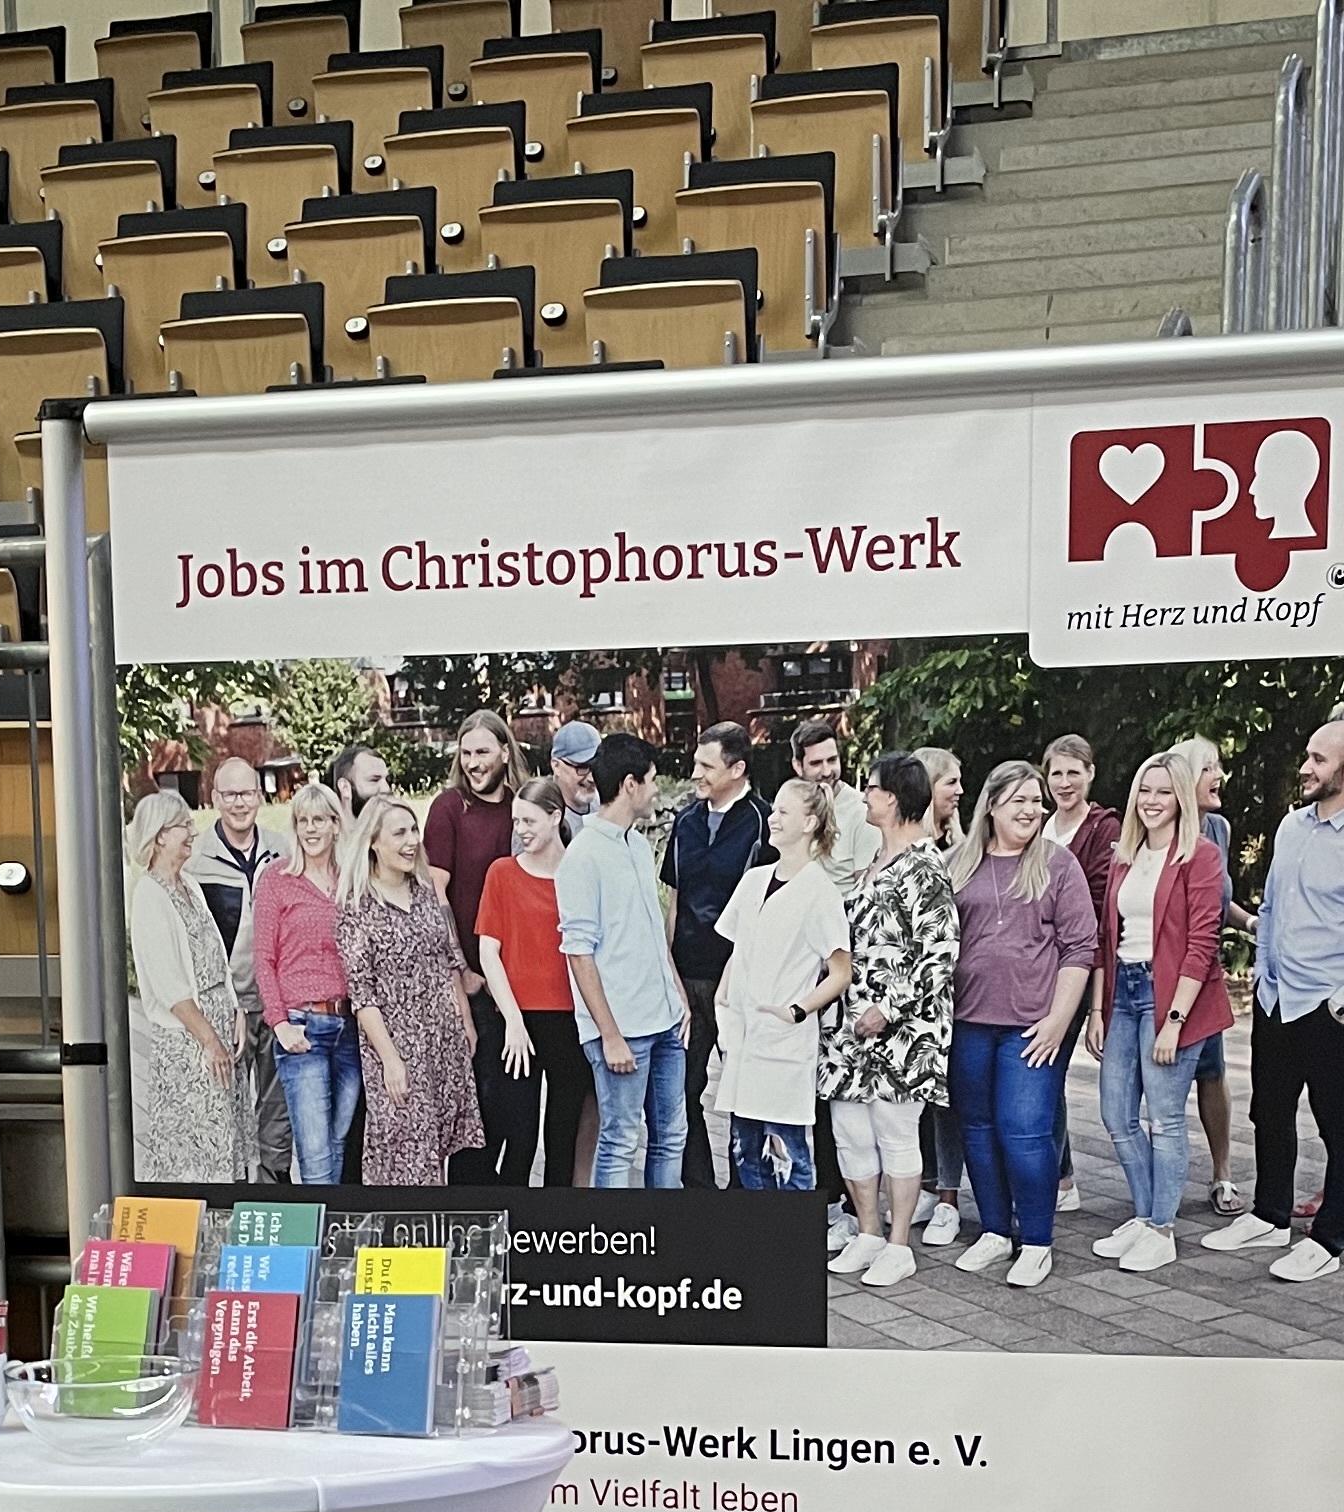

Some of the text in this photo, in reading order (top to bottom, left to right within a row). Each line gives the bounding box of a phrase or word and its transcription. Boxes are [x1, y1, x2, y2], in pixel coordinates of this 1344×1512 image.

[176, 516, 962, 608] Jobs im Christophorus-Werk
[1067, 592, 1326, 631] mit Herz und Kopf
[135, 1207, 149, 1243] Wied
[238, 1211, 252, 1247] bis D
[270, 1212, 282, 1233] Ich
[88, 1249, 100, 1275] mal
[102, 1250, 116, 1286] wenn
[118, 1250, 133, 1287] Wäre
[257, 1254, 270, 1281] Wir
[364, 1258, 374, 1284] uns
[381, 1258, 392, 1277] Du
[68, 1293, 82, 1318] das
[85, 1295, 98, 1321] Wie
[209, 1300, 227, 1375] Vergnügen
[228, 1300, 244, 1362] dann das
[350, 1303, 365, 1347] haben
[364, 1303, 380, 1375] nicht alles
[380, 1303, 396, 1373] Man kann
[239, 1301, 260, 1402] Erst die Arbeit,
[769, 1429, 895, 1471] Lingen
[908, 1441, 941, 1466] e.
[954, 1435, 988, 1468] V.
[590, 1478, 700, 1510] Vielfalt
